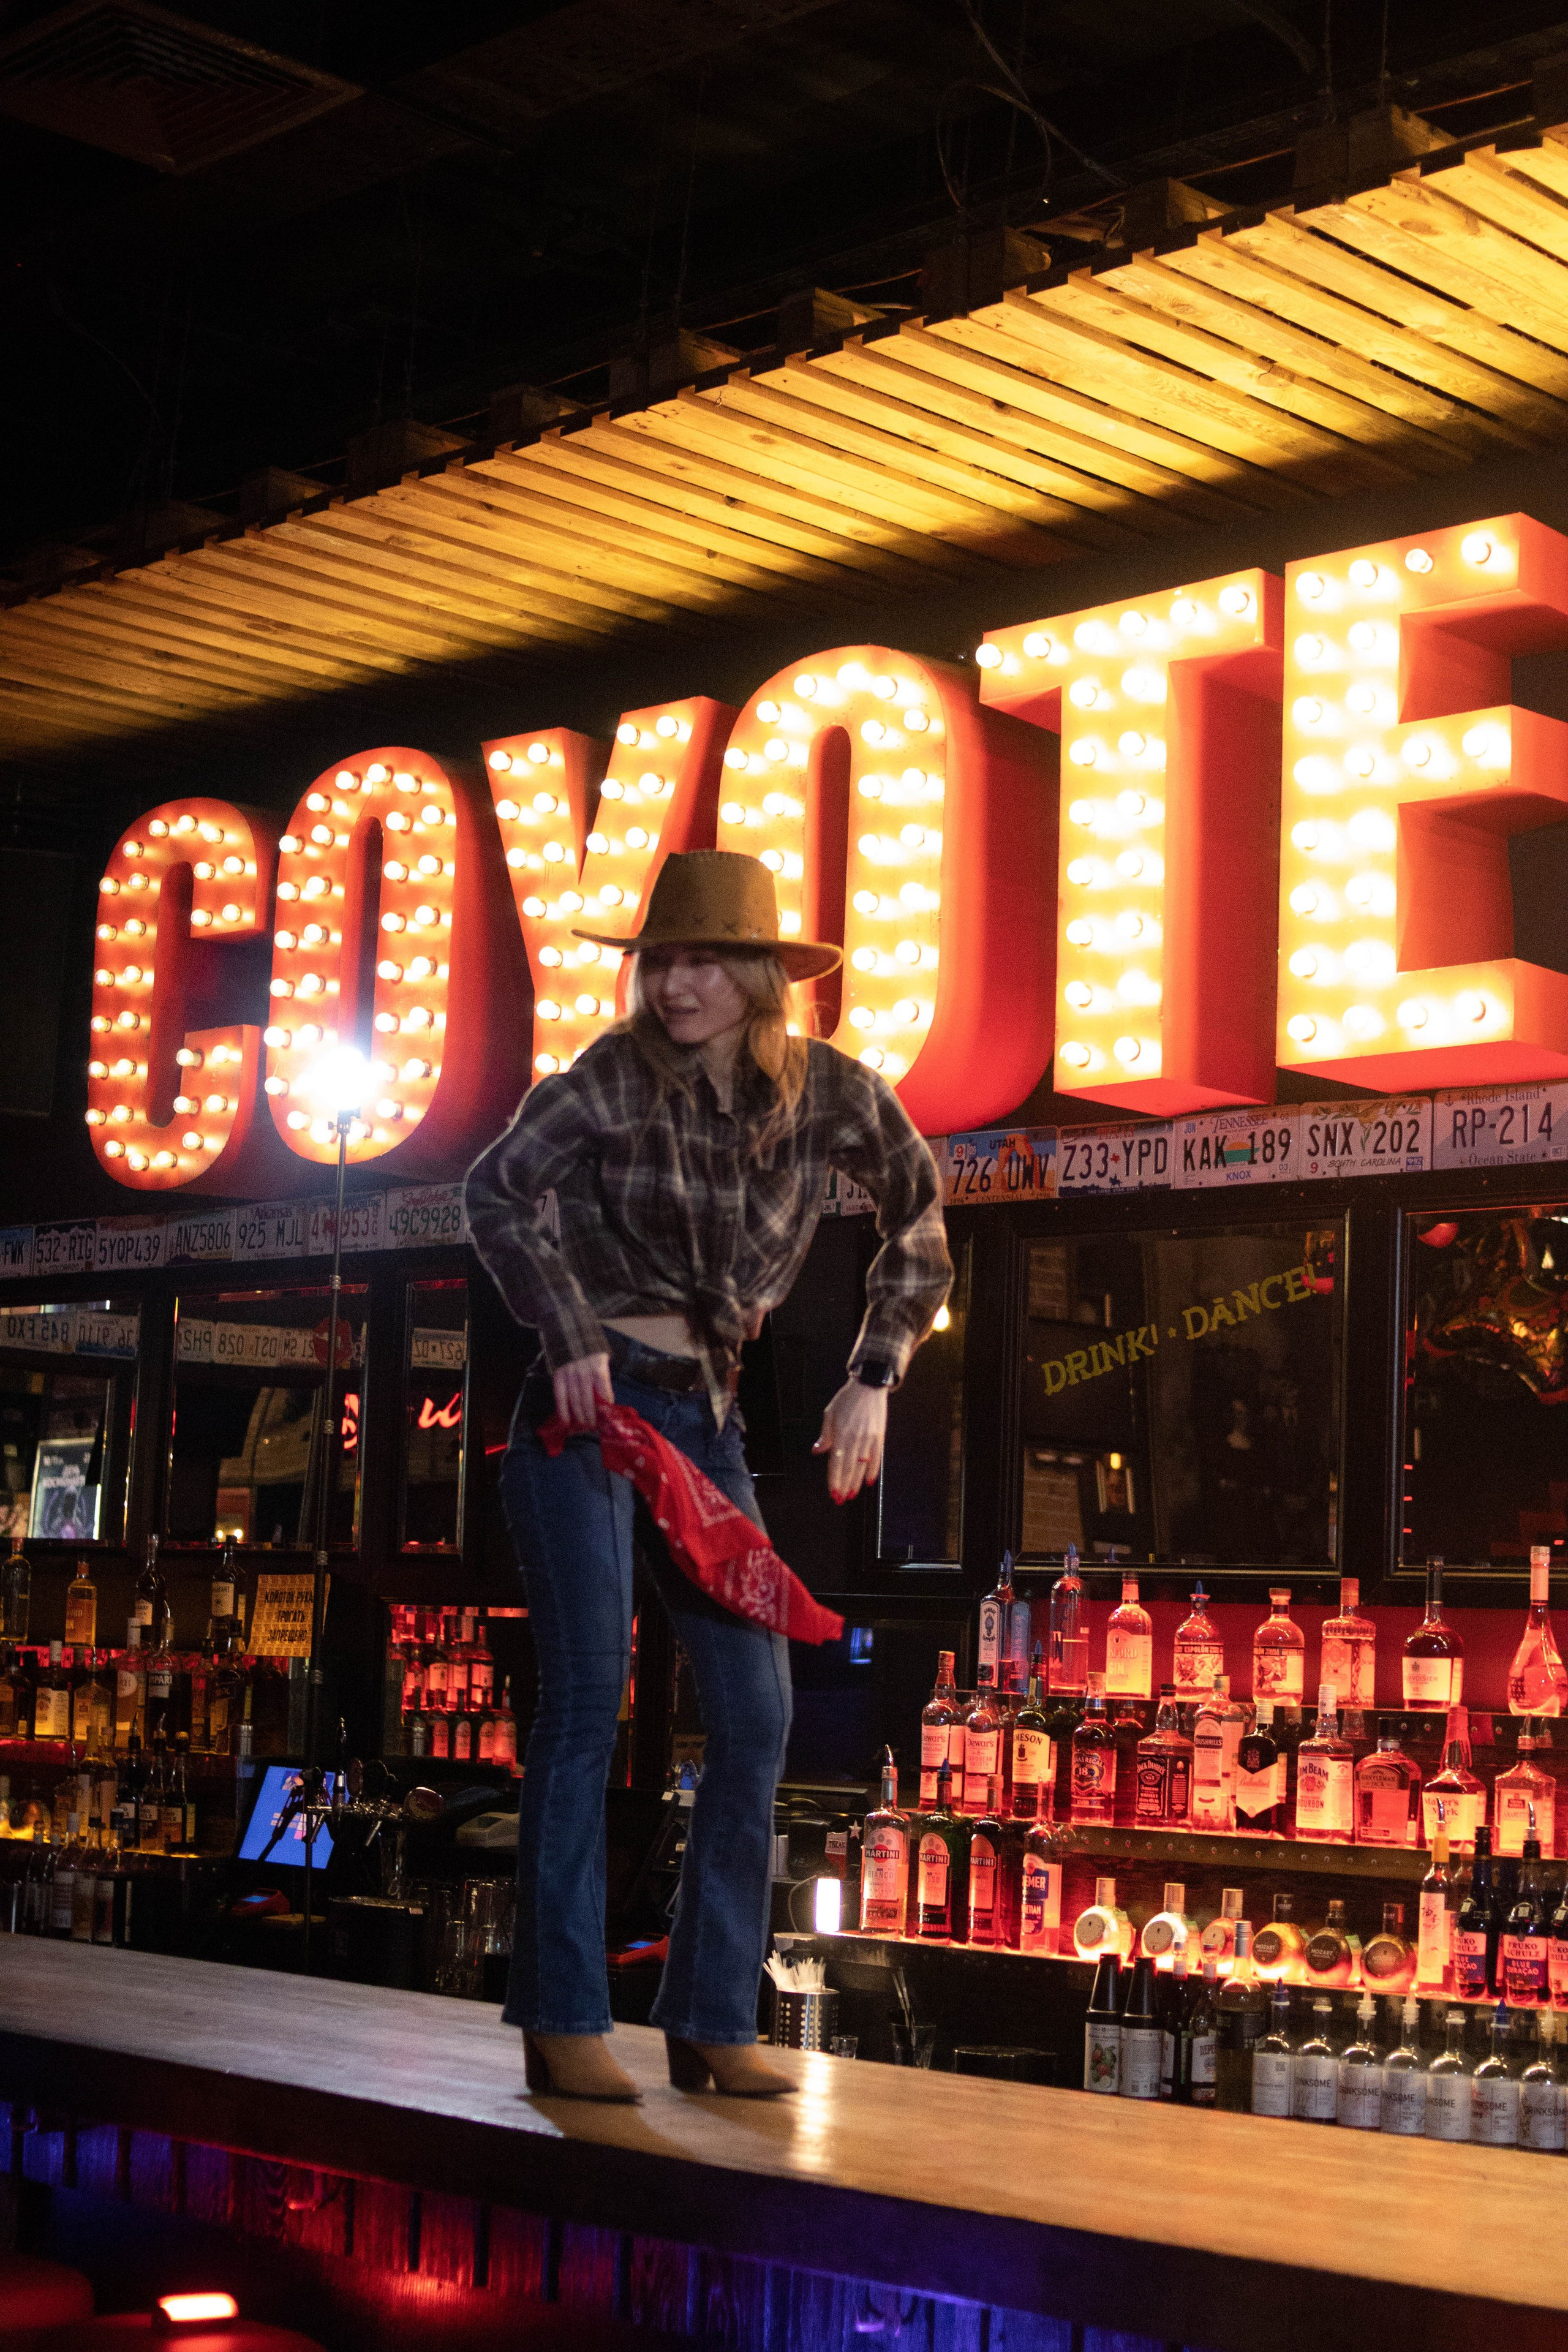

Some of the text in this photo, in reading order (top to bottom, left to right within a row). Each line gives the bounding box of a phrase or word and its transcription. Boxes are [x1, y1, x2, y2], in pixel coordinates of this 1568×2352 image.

[85, 511, 1568, 1191] COYOTE
[1506, 1086, 1540, 1101] Island
[1307, 1119, 1420, 1156] SNX 202
[1452, 1102, 1553, 1148] RP-214
[990, 1138, 1016, 1149] UTAH
[1183, 1128, 1291, 1172] KAK 189
[954, 1158, 992, 1194] 726
[1226, 1170, 1251, 1181] KNOX
[866, 1850, 898, 1858] MARTINI
